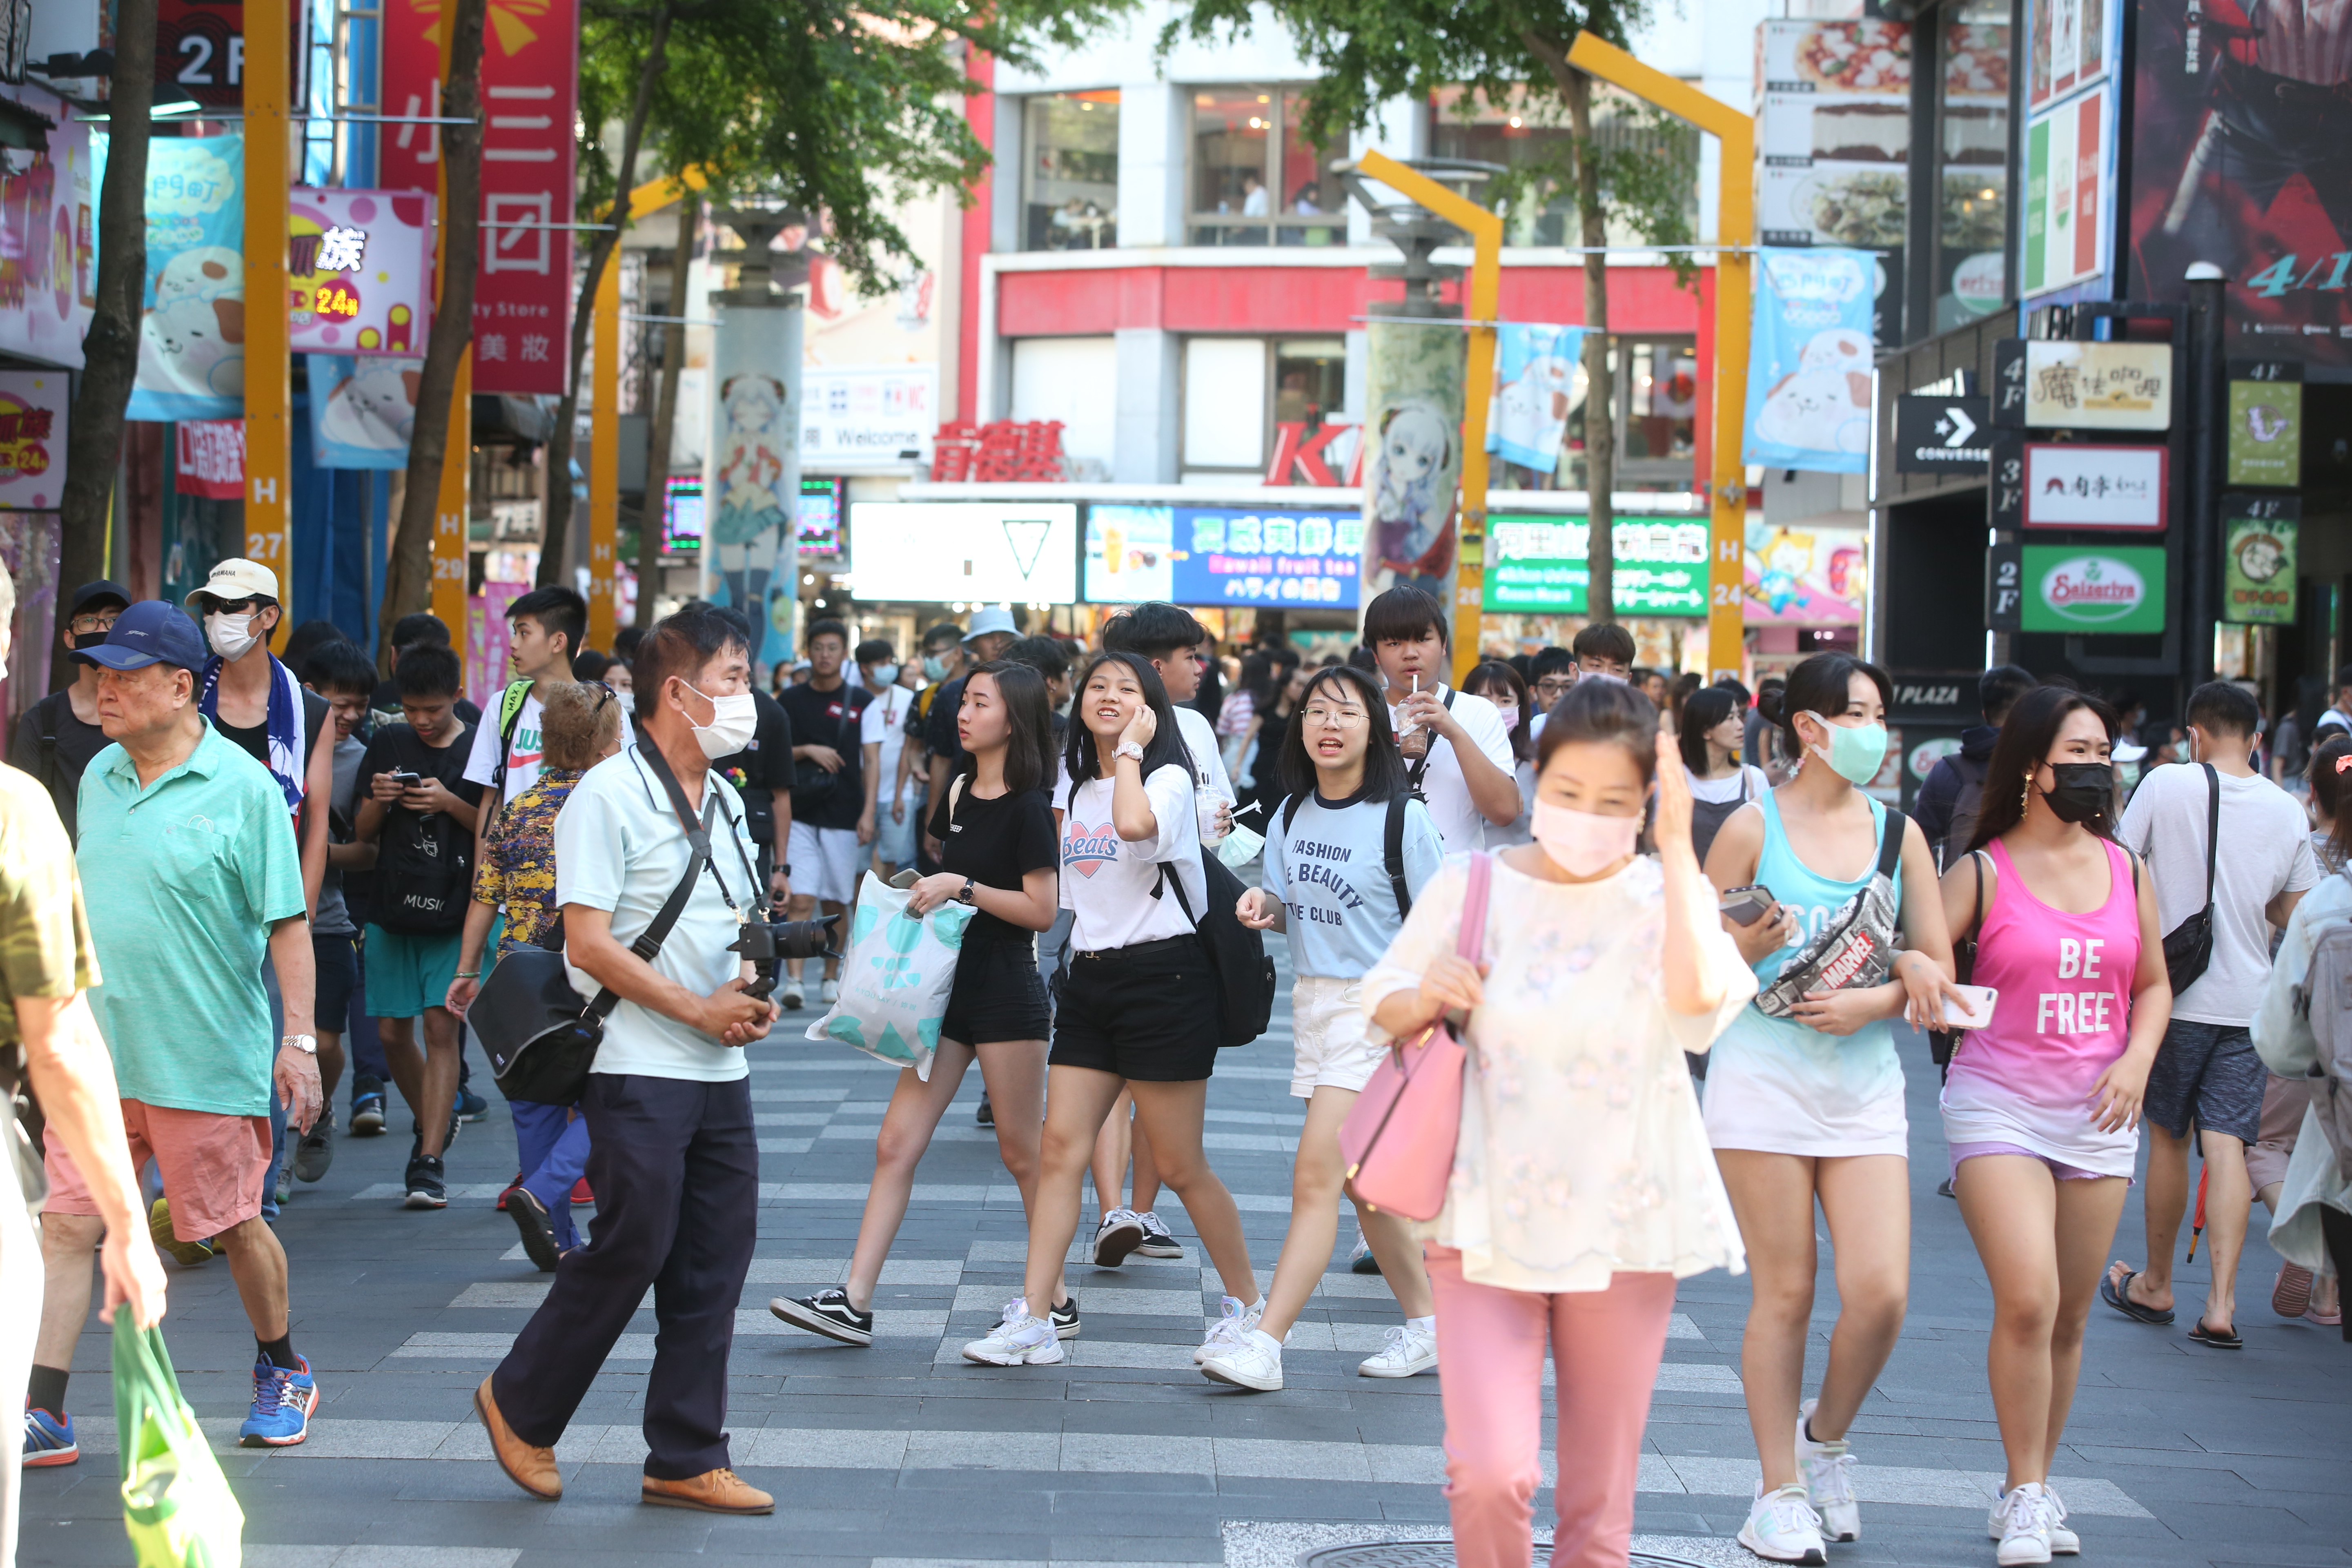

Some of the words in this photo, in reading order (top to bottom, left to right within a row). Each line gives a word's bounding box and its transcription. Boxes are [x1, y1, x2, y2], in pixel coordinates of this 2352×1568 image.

[2247, 251, 2352, 298] 4/1
[497, 301, 549, 317] Store
[835, 428, 918, 446] Welcome
[931, 418, 1066, 482] 肯德基
[1915, 447, 1991, 461] CONVERSE
[254, 477, 276, 504] H
[440, 513, 459, 535] H
[248, 532, 283, 559] 27
[595, 543, 610, 561] H
[1720, 540, 1738, 561] H
[435, 558, 463, 579] 29
[1277, 556, 1321, 575] fruit
[1325, 558, 1356, 575] tea
[591, 578, 612, 595] 31
[1458, 588, 1480, 606] 26
[1715, 584, 1742, 606] 24
[1996, 561, 2018, 613] 2F
[508, 689, 519, 711] MAX
[1900, 686, 1959, 704] PLAZA
[1063, 833, 1118, 858] beats
[1298, 863, 1364, 909] BEAUTY
[1310, 906, 1343, 926] CLUB
[1821, 935, 1874, 990] MARVEL
[2058, 938, 2105, 979] BE
[877, 995, 890, 1004] SAY
[2036, 991, 2116, 1035] FREE
